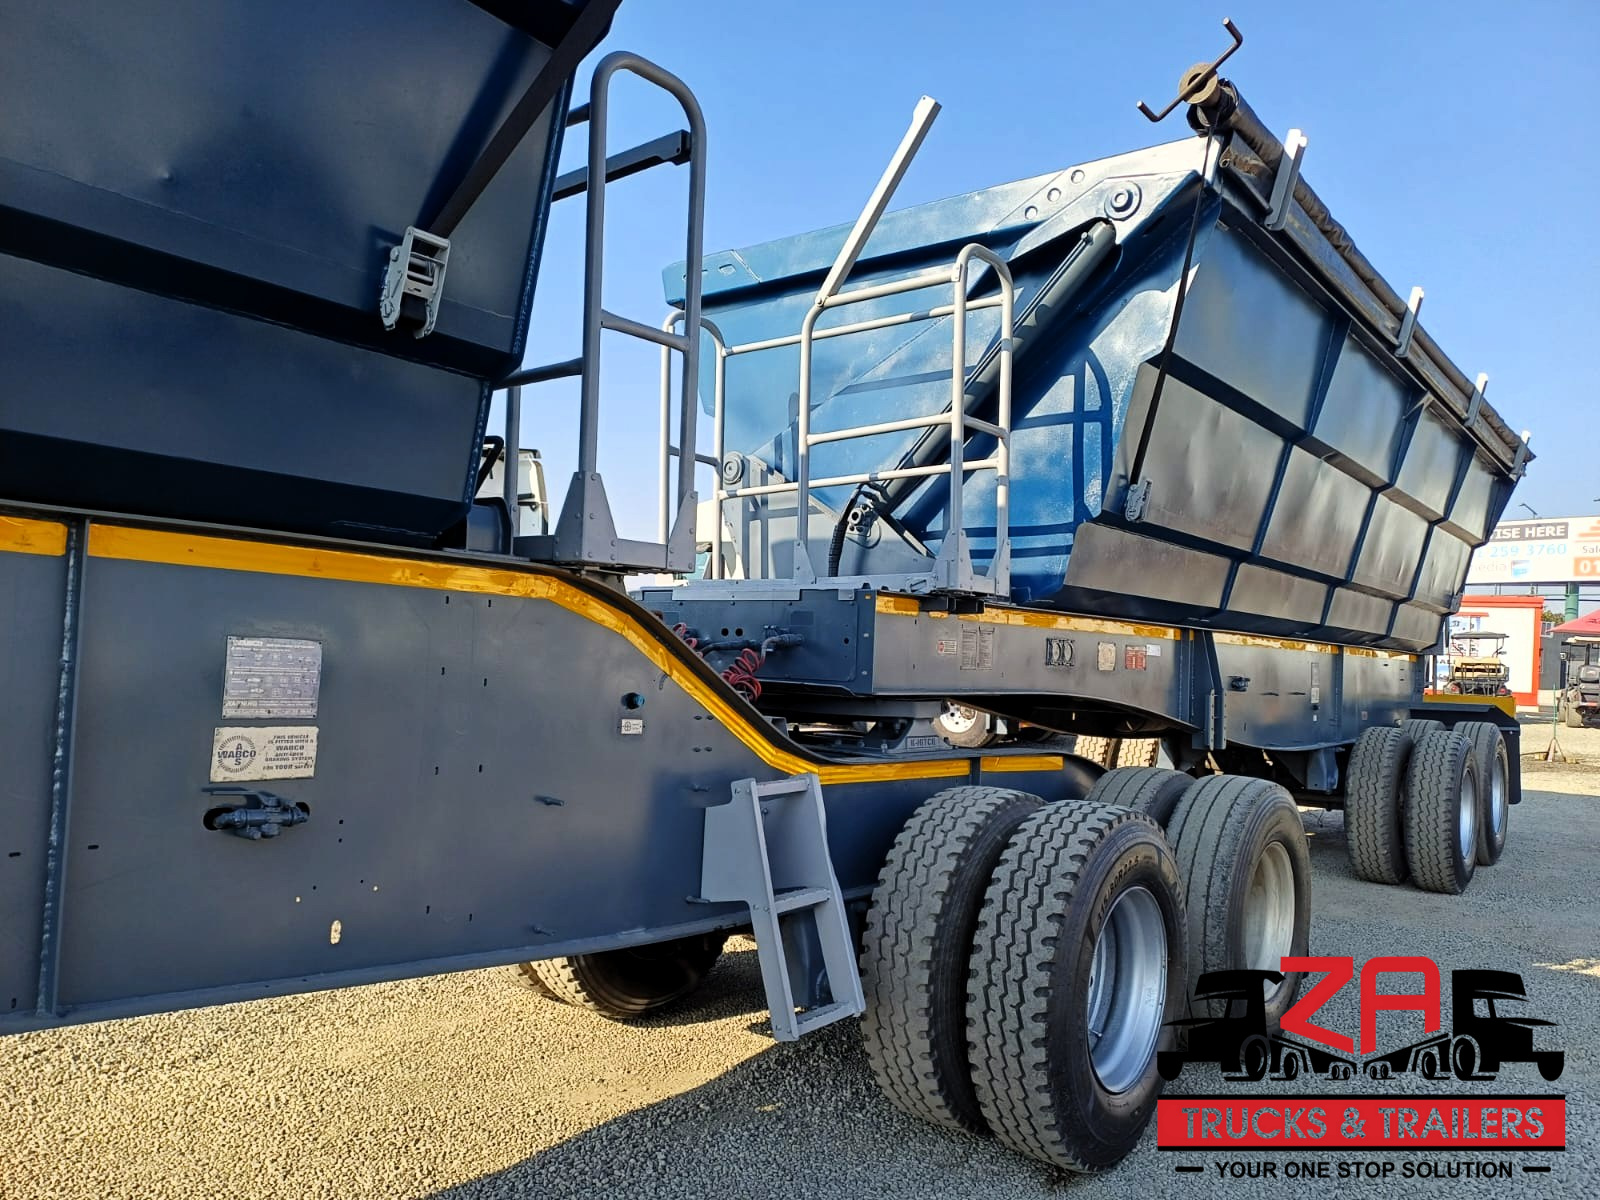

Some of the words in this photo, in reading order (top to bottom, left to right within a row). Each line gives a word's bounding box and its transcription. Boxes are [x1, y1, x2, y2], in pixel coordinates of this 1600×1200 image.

[1524, 525, 1566, 538] HERE
[1490, 545, 1519, 558] 259
[1527, 543, 1567, 556] 3760
[217, 749, 257, 759] WABCO
